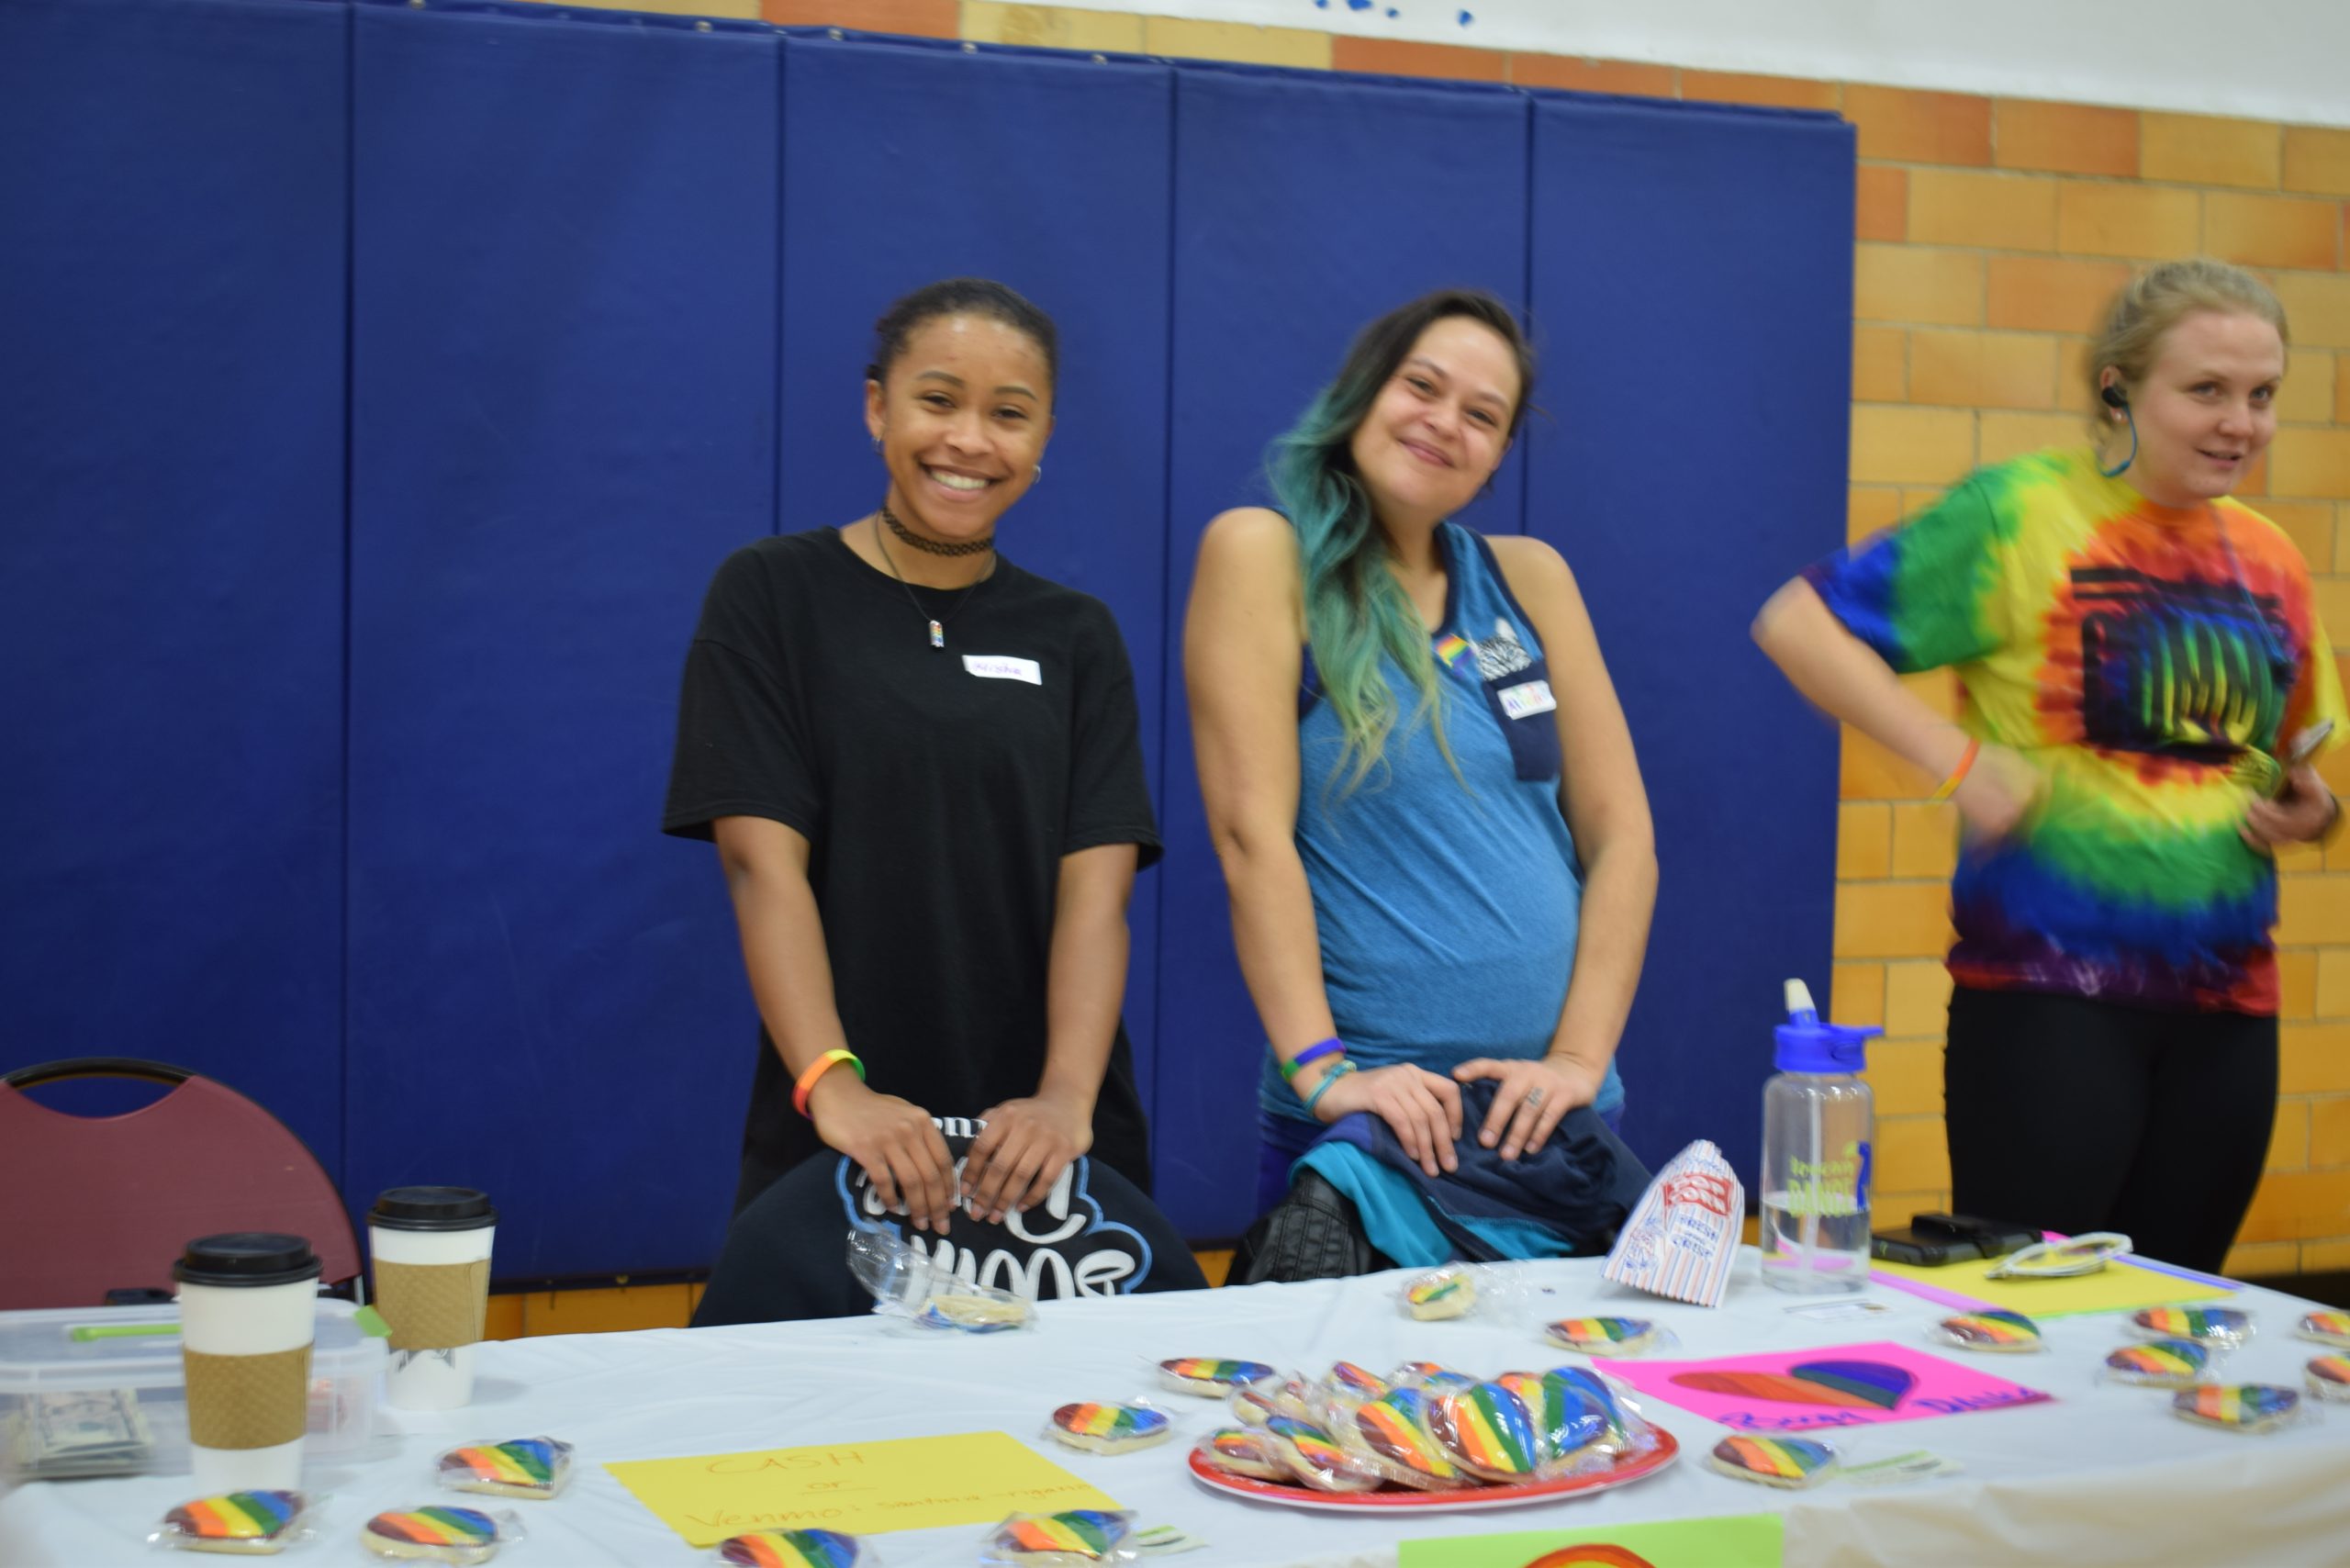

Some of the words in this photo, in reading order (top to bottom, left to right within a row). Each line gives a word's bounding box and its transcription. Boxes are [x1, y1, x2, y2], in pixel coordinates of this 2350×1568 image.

[1679, 1214, 1720, 1242] FRESH
[707, 1451, 866, 1475] CASH
[807, 1479, 853, 1492] or
